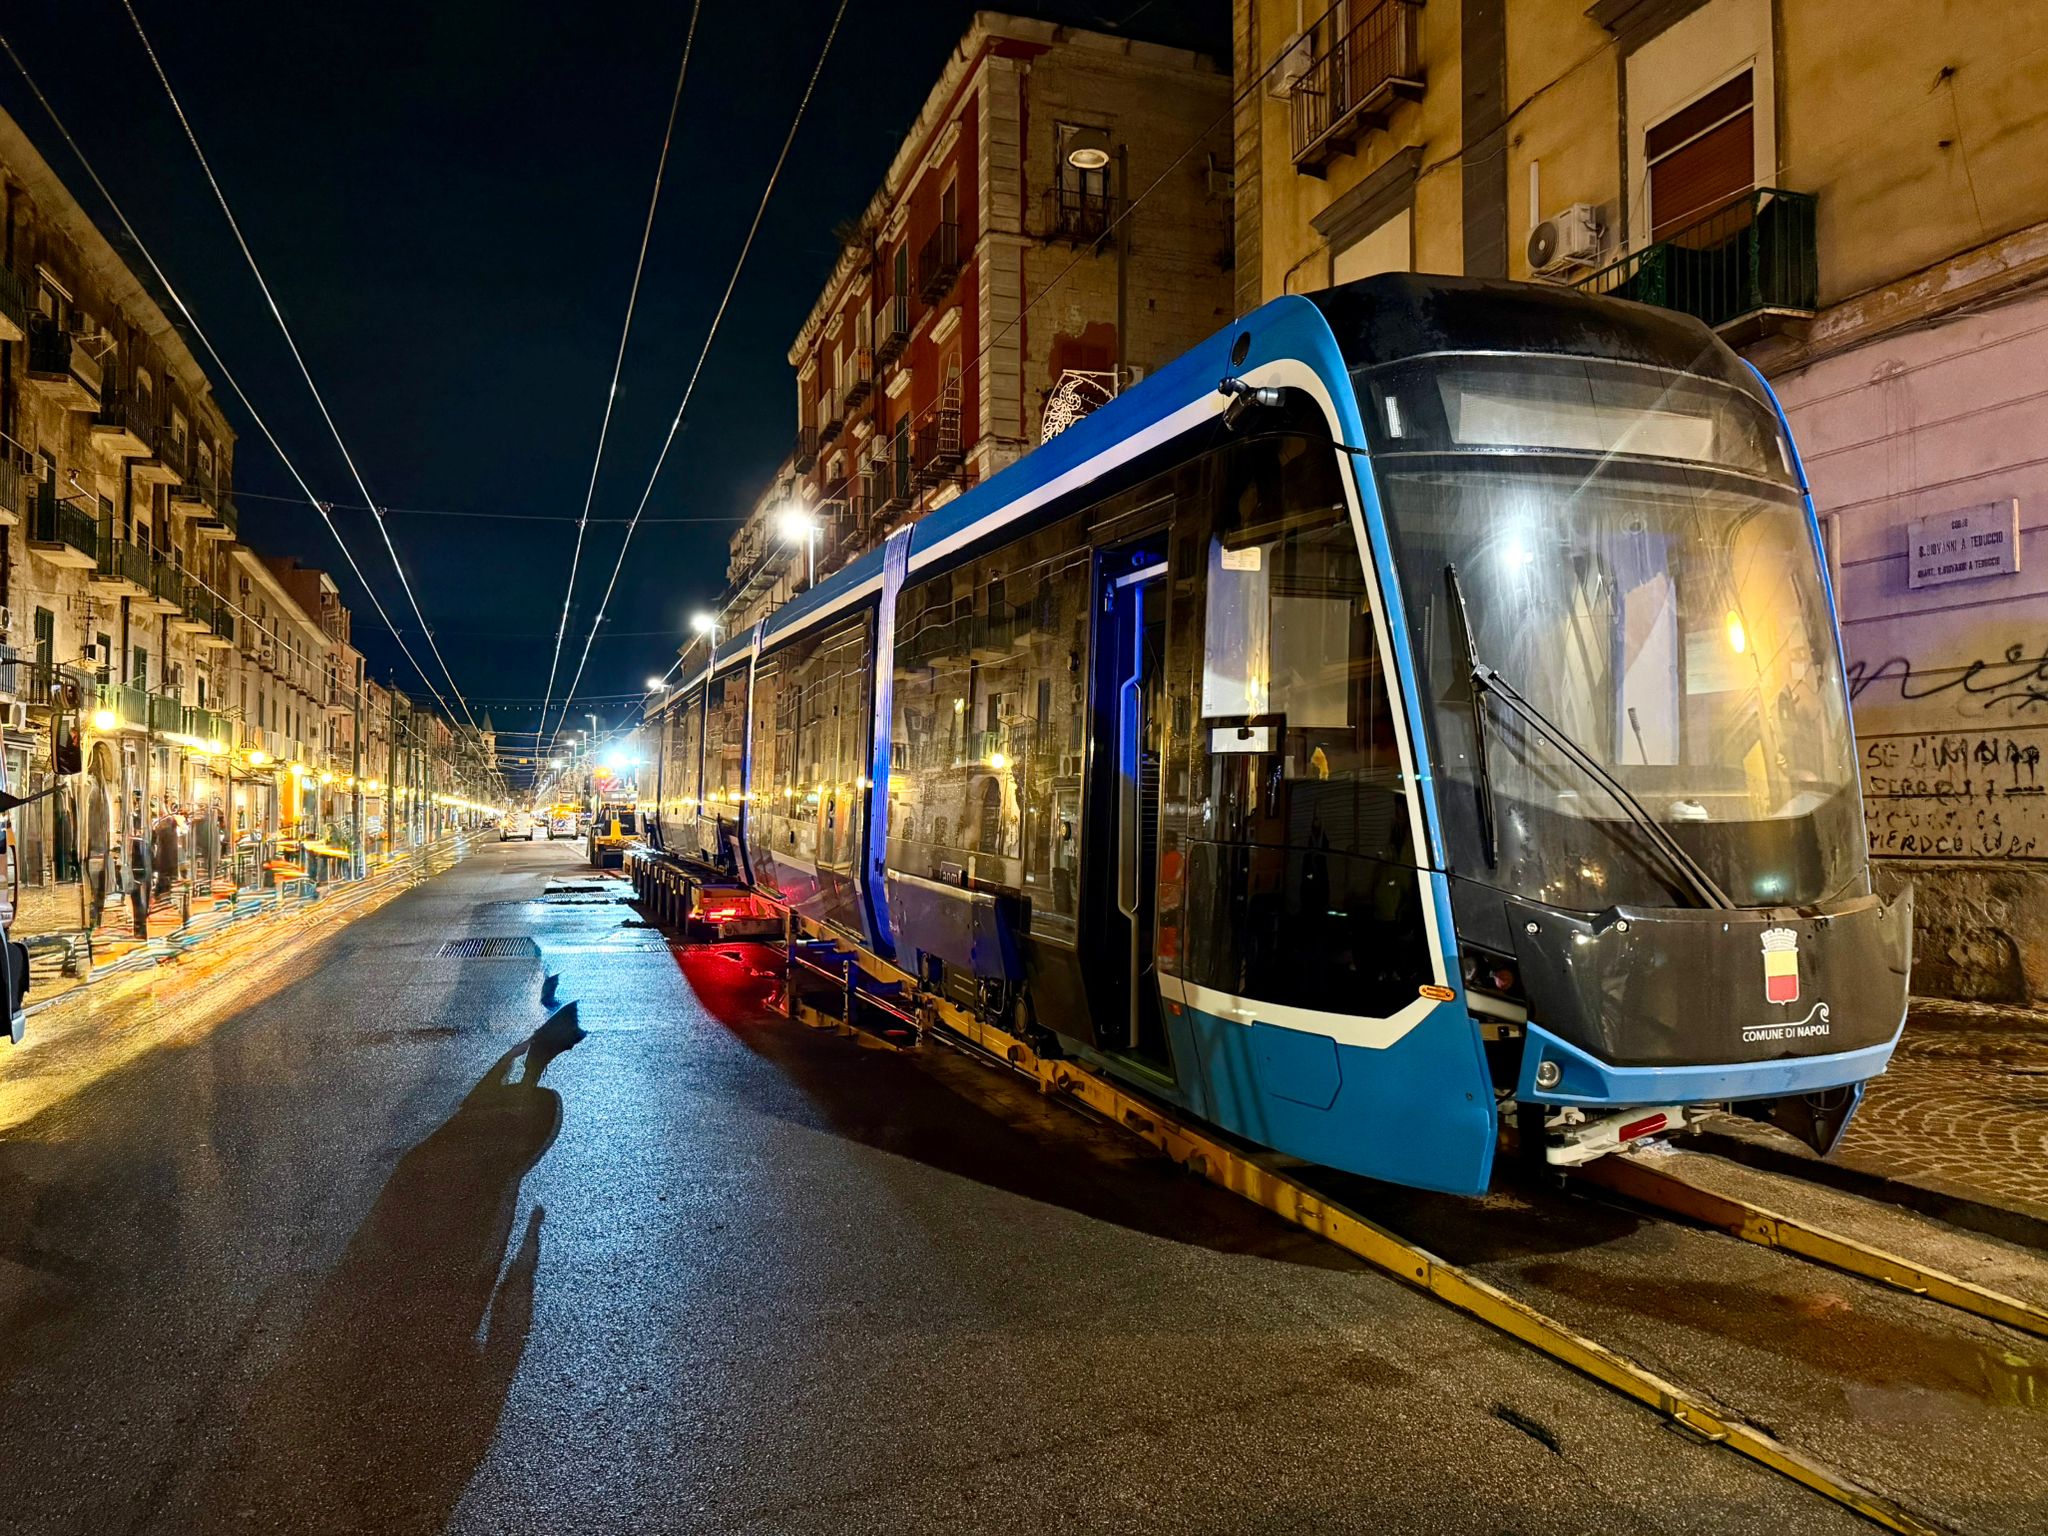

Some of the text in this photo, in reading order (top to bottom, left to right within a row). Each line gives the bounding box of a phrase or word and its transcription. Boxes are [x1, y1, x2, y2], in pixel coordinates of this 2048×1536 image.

[1961, 538, 1966, 550] A
[1968, 561, 1973, 570] A
[1742, 1024, 1830, 1042] COMUNE DI NAPOLI
